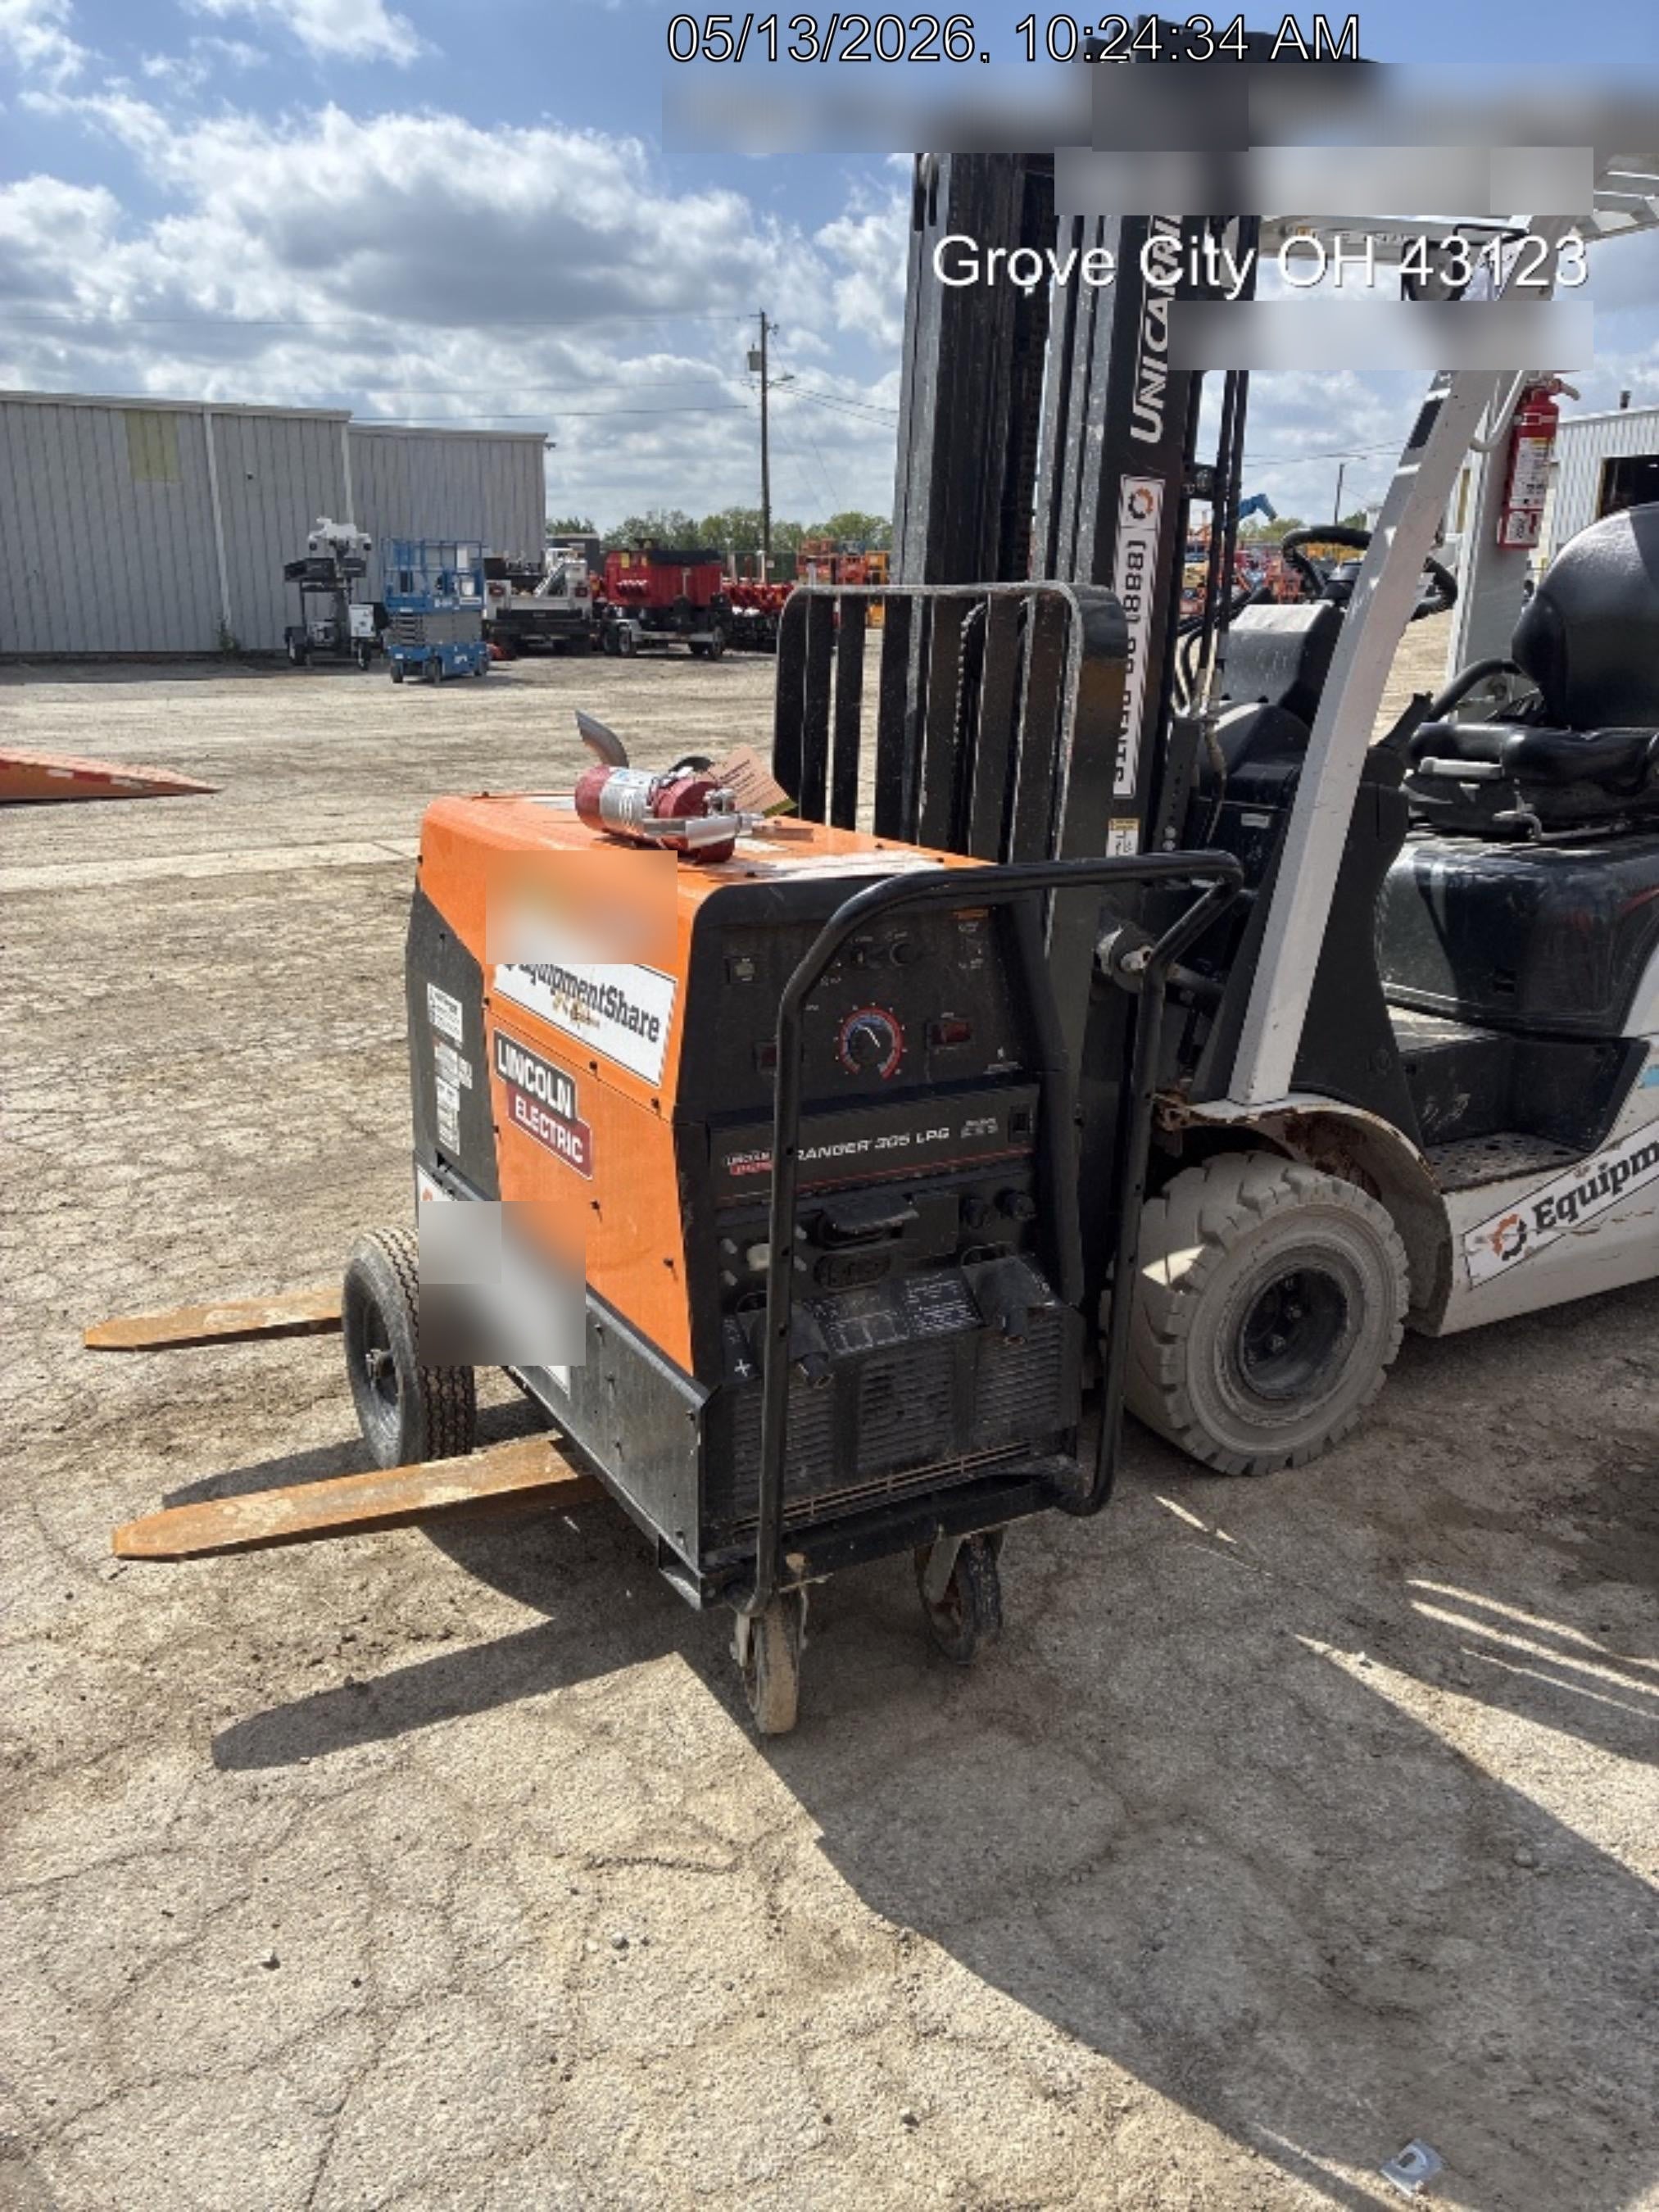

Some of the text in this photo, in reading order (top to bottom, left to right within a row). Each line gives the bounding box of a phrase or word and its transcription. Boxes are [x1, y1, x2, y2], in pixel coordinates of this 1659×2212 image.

[497, 1038, 573, 1119] LINCOLN
[514, 1095, 583, 1163] ELECTRIC
[874, 1134, 910, 1150] 305
[915, 1126, 950, 1145] LPG
